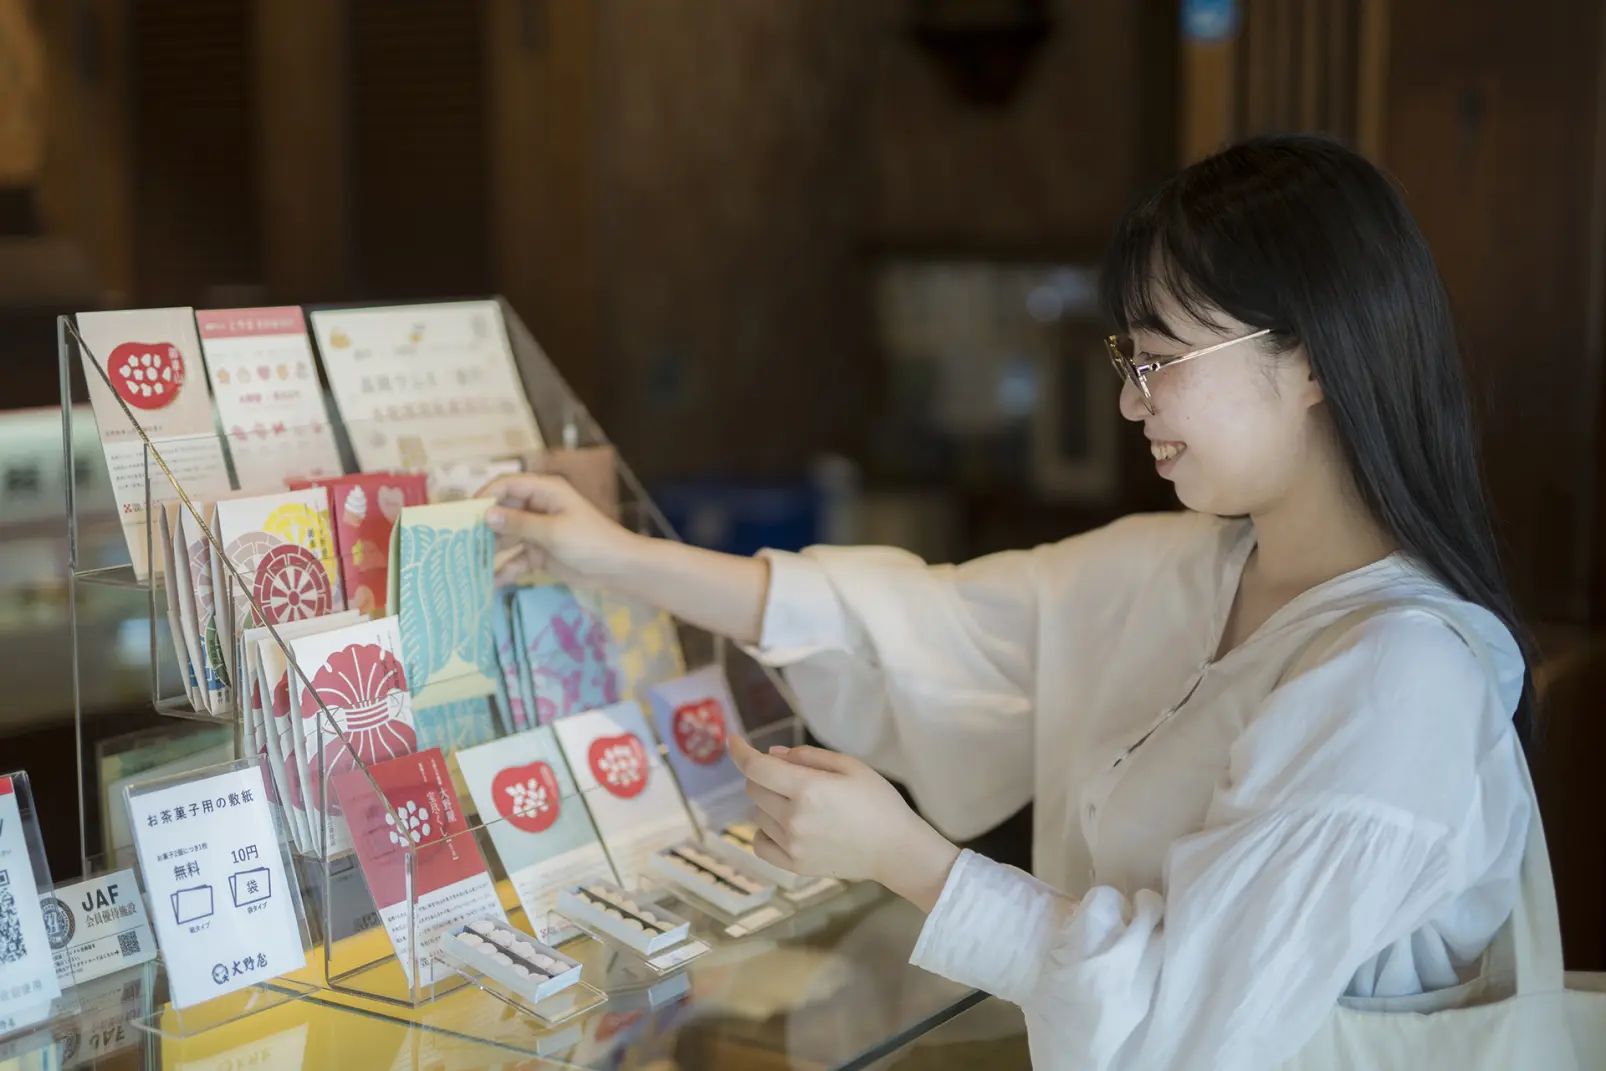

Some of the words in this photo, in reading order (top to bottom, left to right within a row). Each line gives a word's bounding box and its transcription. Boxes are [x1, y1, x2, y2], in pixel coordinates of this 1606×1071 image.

[147, 789, 254, 828] お茶菓子用の敷紙
[231, 844, 259, 864] 10円
[173, 860, 201, 881] 無料
[82, 884, 119, 912] JAF
[246, 879, 259, 894] 袋
[85, 901, 137, 928] 会員優待施設
